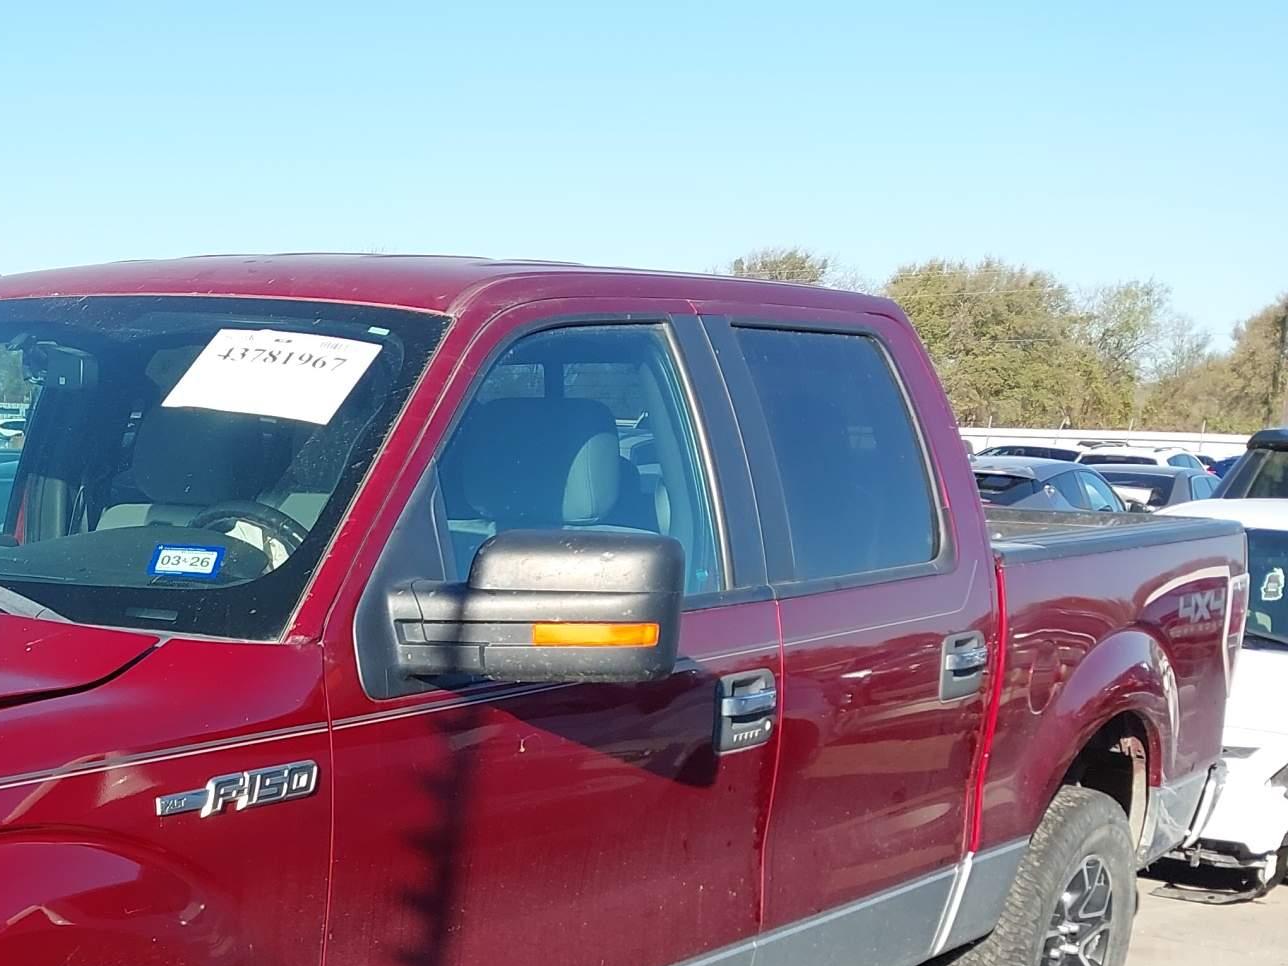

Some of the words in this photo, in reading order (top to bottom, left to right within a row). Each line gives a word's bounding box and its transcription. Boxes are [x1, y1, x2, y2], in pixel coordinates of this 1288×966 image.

[216, 346, 348, 373] 43781967
[159, 554, 182, 567] 03
[188, 556, 211, 568] 26
